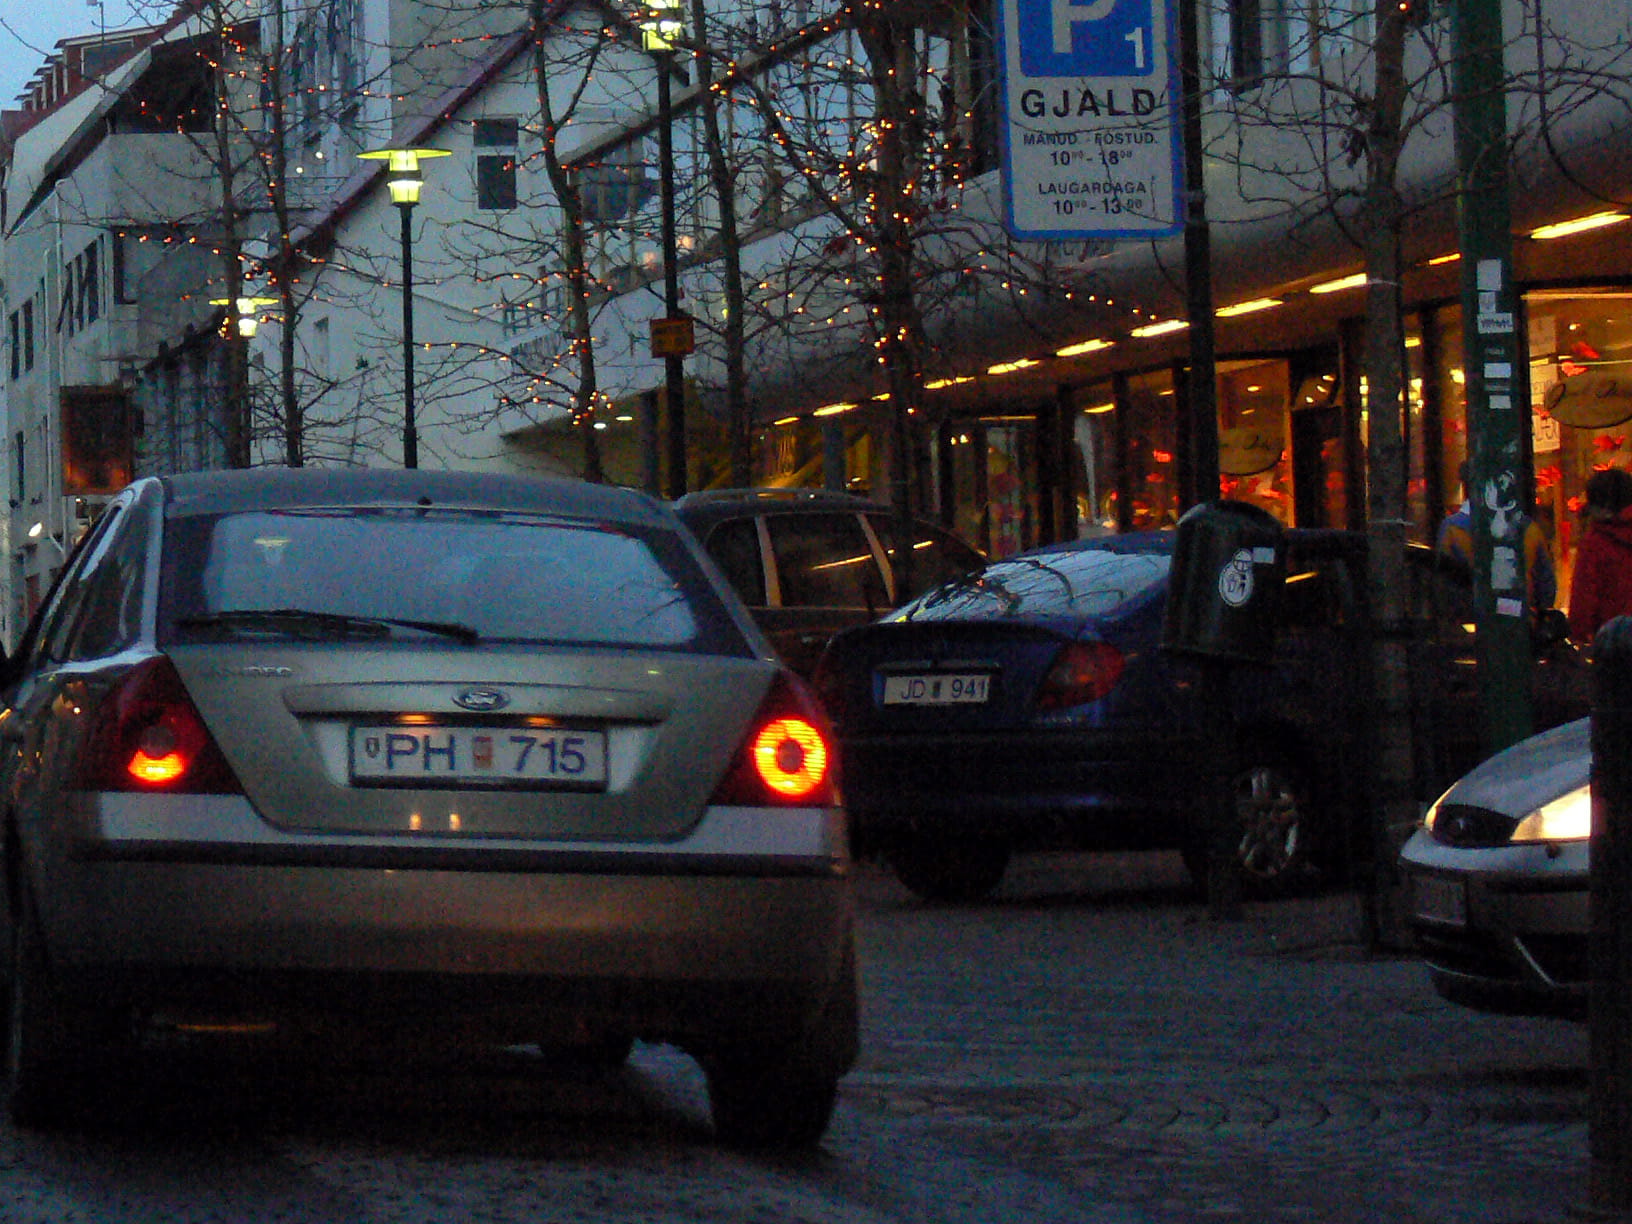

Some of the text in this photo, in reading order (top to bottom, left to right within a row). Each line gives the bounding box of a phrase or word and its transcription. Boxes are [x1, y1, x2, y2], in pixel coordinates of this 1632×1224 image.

[1125, 27, 1144, 67] 1
[1020, 88, 1156, 118] GJALD
[901, 679, 986, 699] JD 941
[386, 733, 587, 775] PH 715
